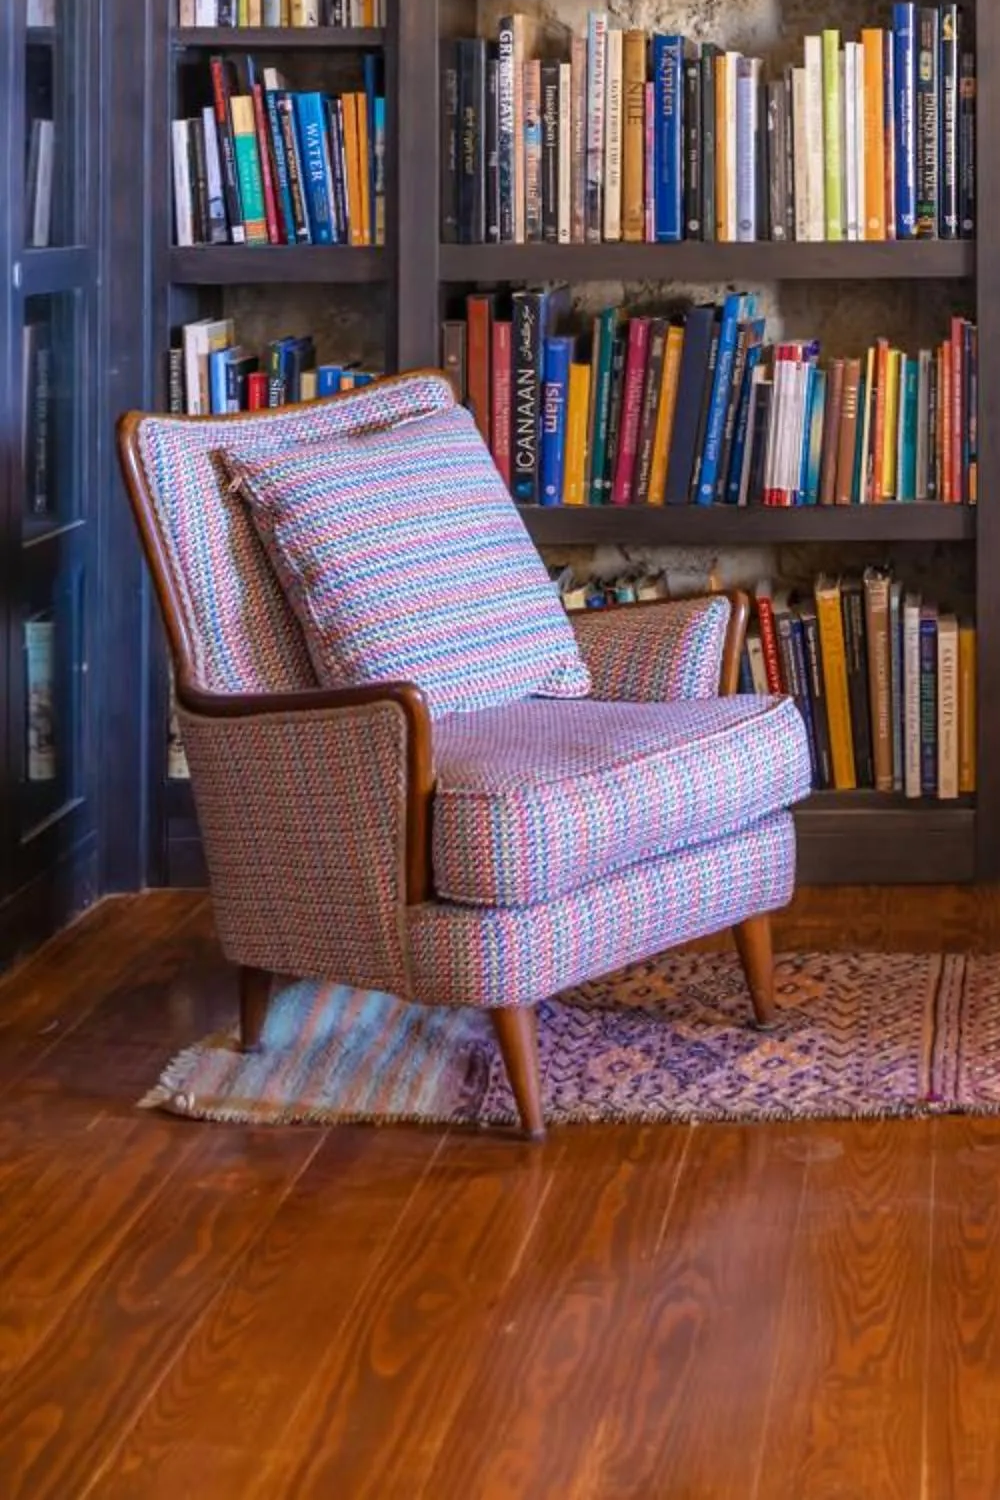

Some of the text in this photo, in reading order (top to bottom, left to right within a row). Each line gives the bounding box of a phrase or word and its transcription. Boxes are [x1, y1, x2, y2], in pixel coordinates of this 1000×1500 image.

[626, 79, 643, 125] NILE
[306, 122, 323, 181] WATER
[269, 379, 283, 408] Sina
[544, 382, 563, 433] Islam
[943, 648, 953, 728] AKHENATEN
